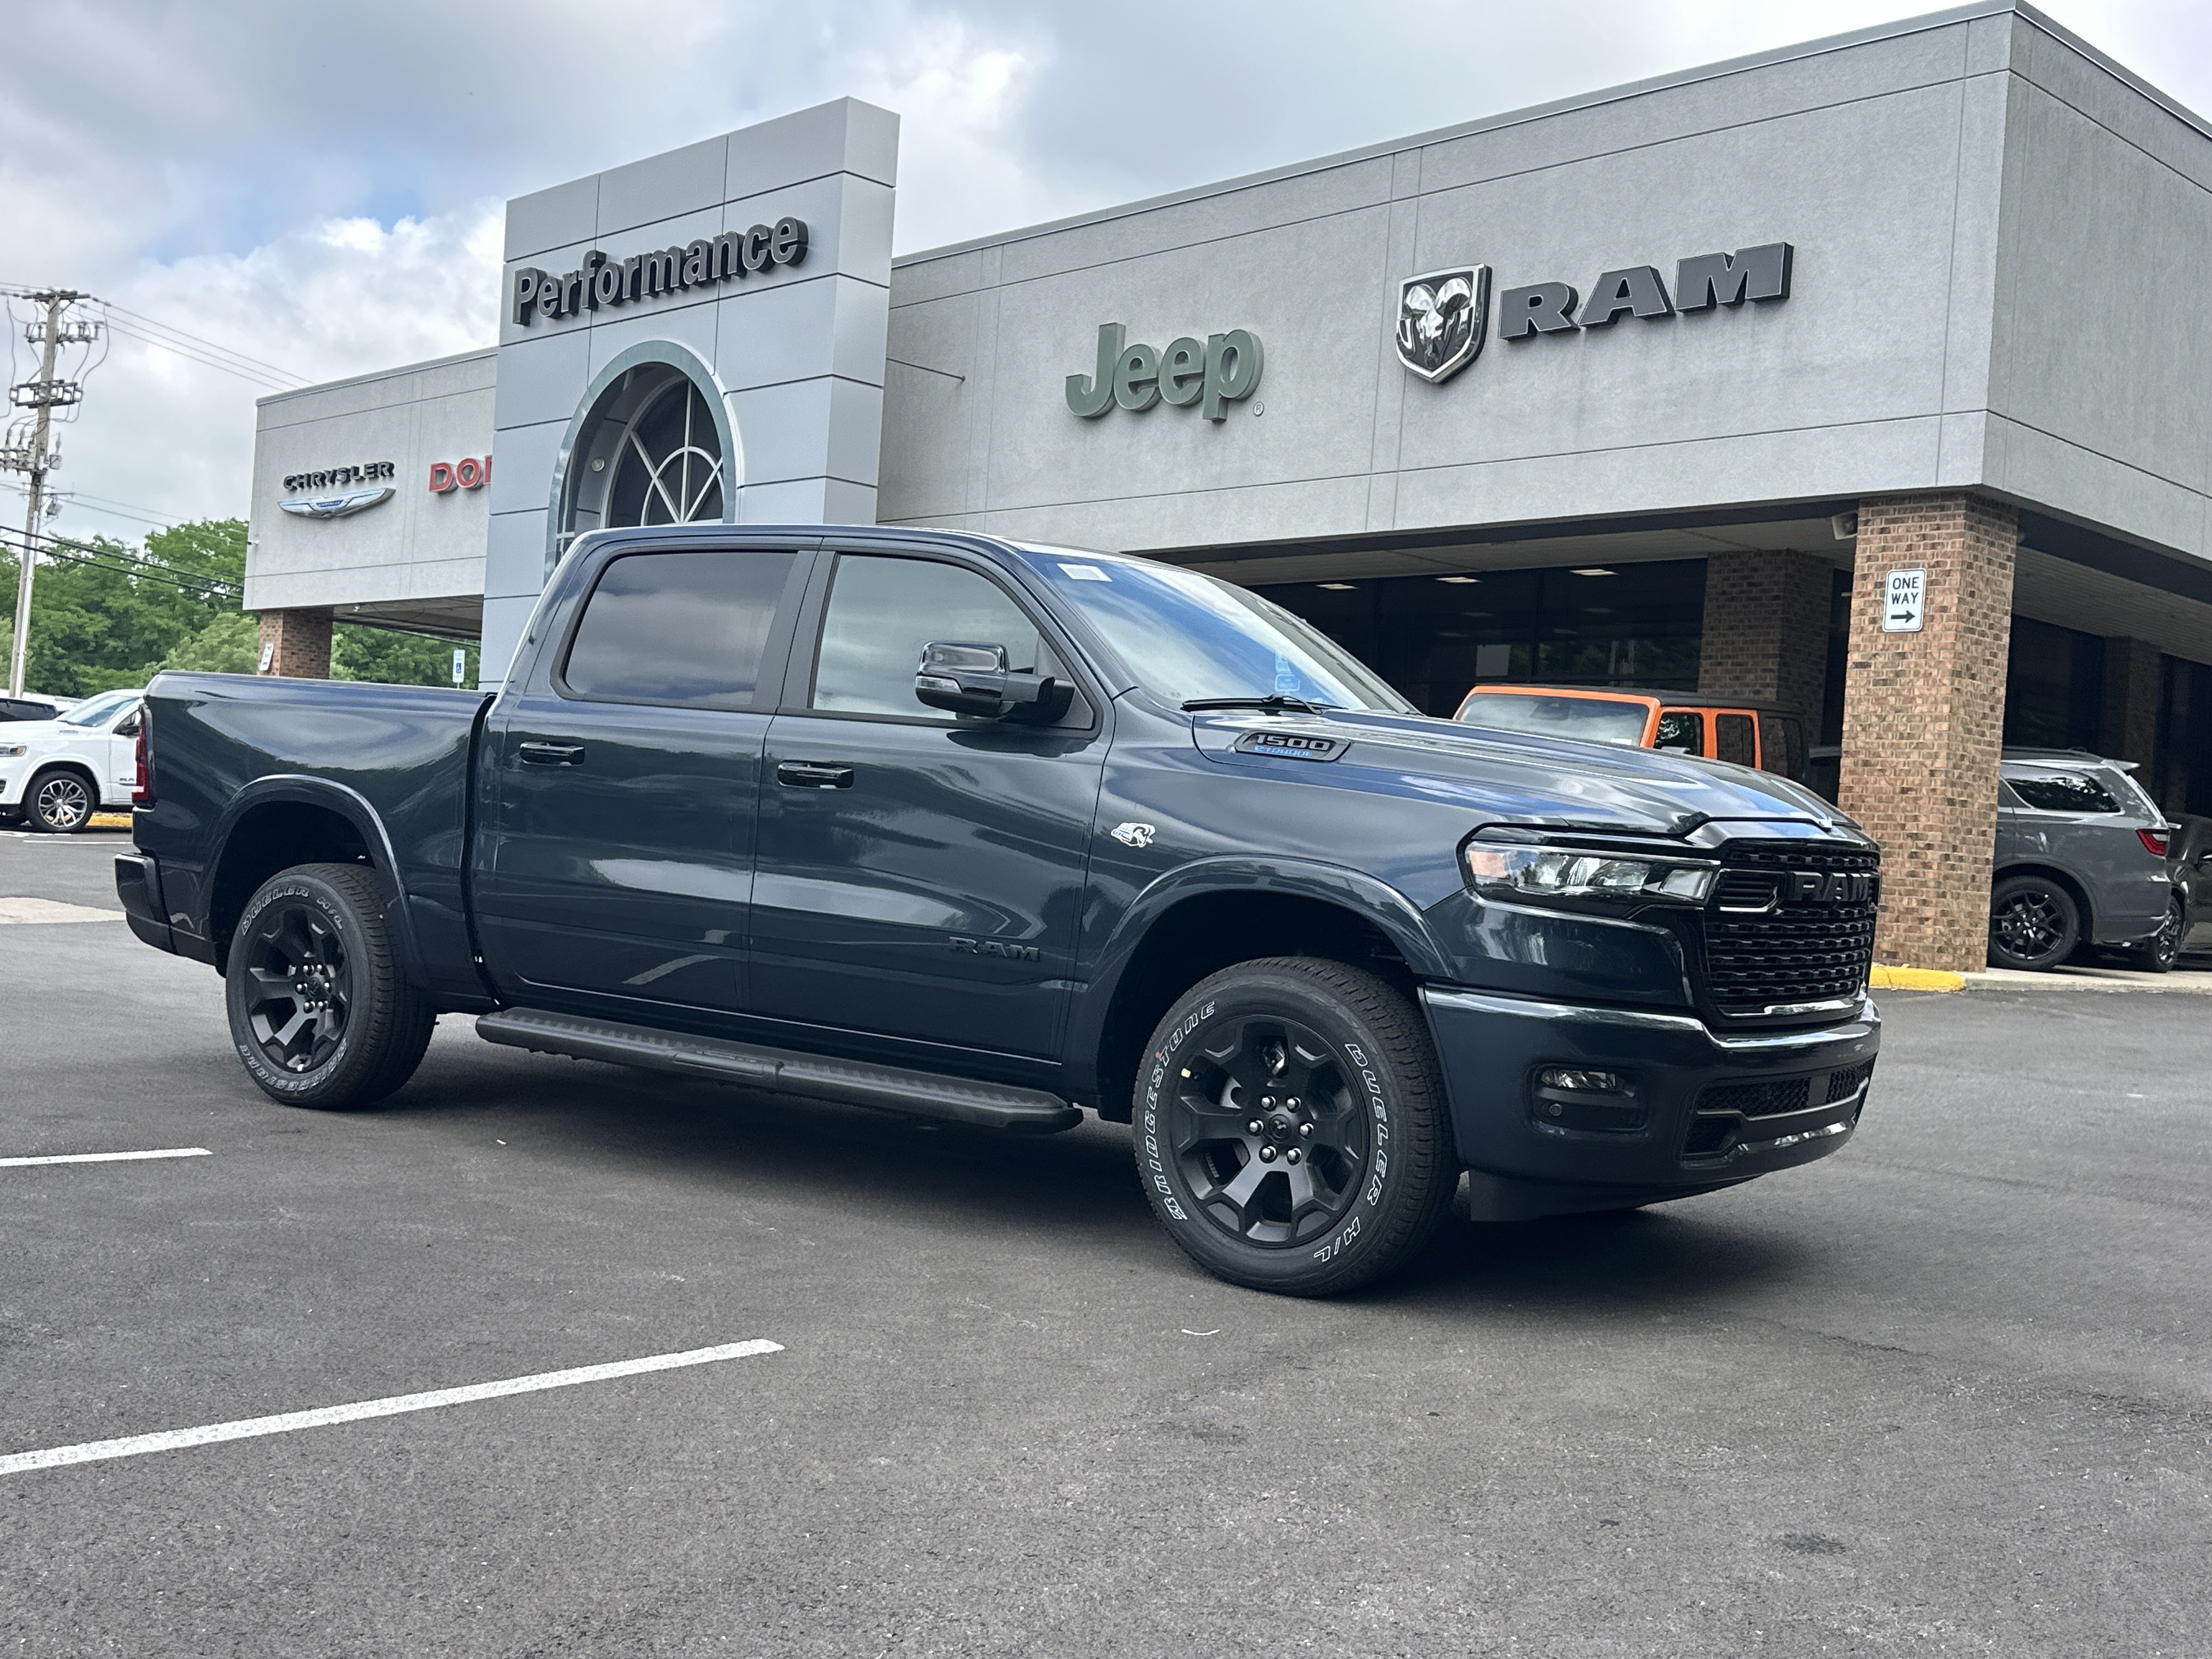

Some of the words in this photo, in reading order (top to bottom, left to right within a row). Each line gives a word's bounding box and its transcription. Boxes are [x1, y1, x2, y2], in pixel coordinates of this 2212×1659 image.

[513, 216, 809, 326] Performance
[1497, 241, 1794, 342] RAM
[1065, 322, 1264, 421] Jeep
[283, 461, 395, 490] CHRYSLER
[1892, 592, 1918, 605] WAY
[1893, 577, 1919, 589] ONE
[1257, 734, 1330, 751] 1500
[1792, 871, 1871, 901] RAM
[241, 886, 309, 935] DUELER
[949, 936, 1041, 961] RAM
[1144, 1001, 1216, 1221] BRIDGESTONE
[1344, 1043, 1389, 1206] DUELER
[1313, 1216, 1361, 1262] H/L
